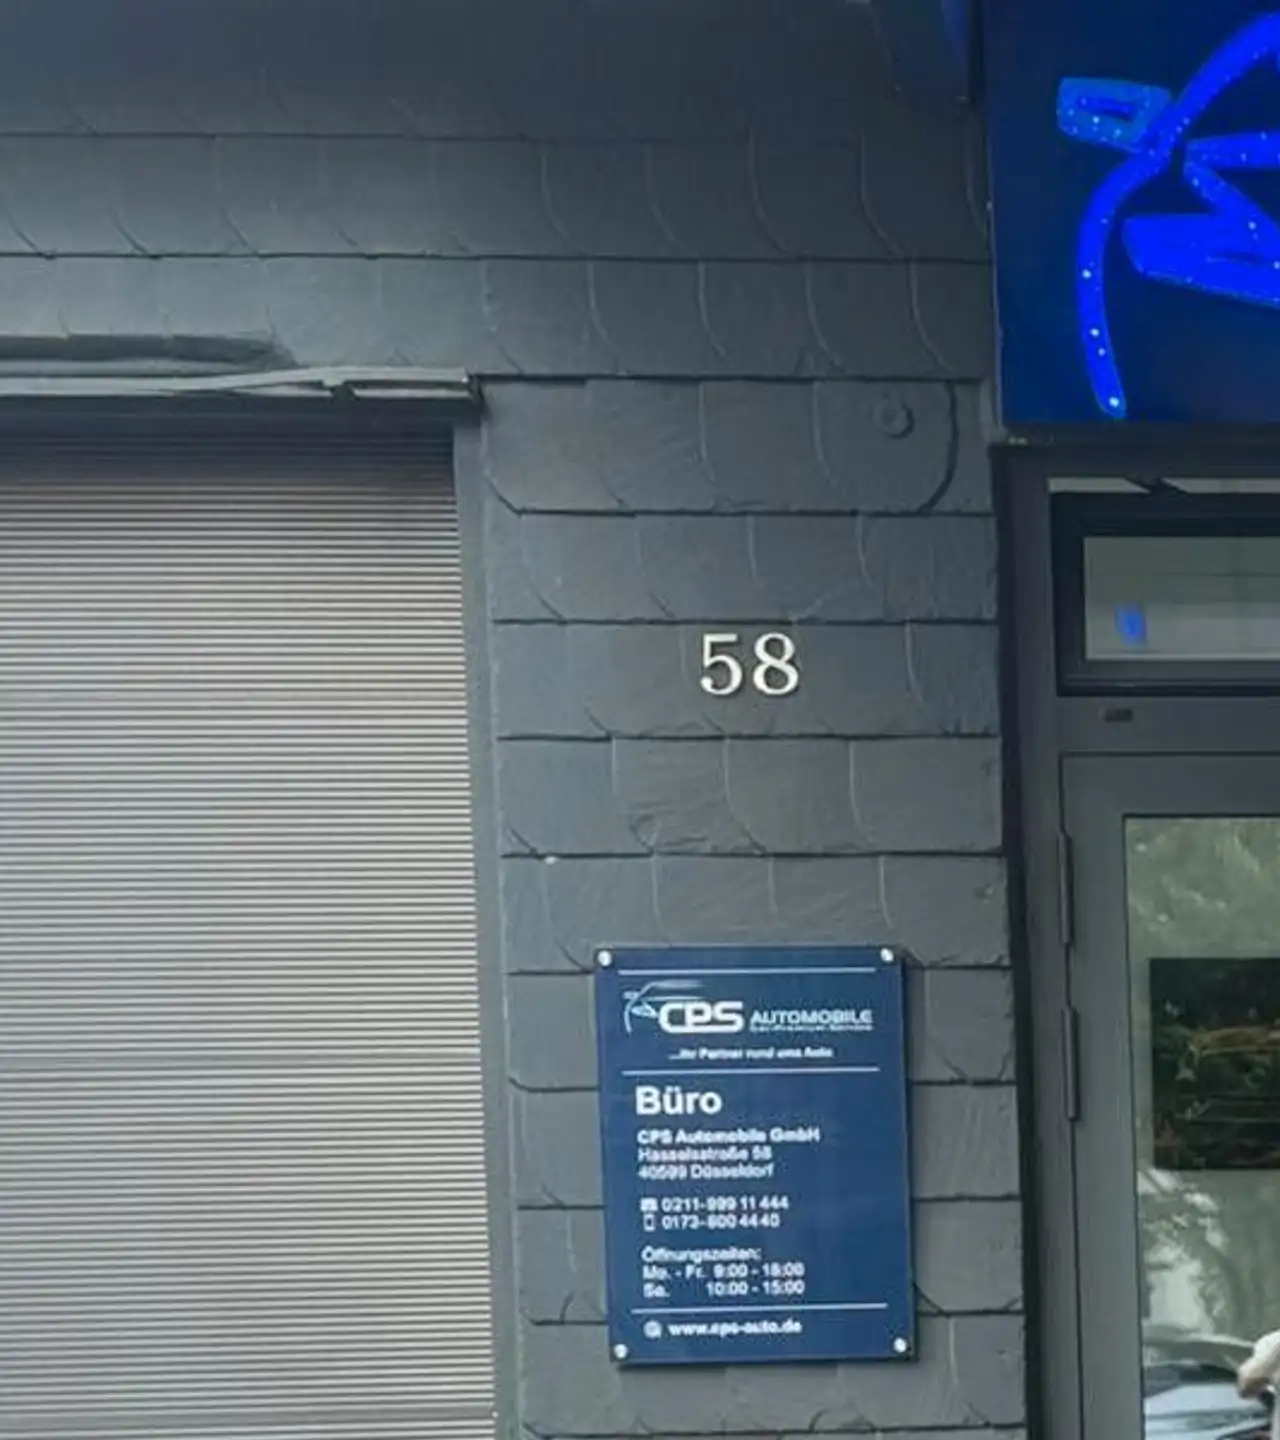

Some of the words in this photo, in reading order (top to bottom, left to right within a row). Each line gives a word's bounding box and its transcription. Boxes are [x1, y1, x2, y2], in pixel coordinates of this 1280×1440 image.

[700, 632, 799, 695] 58
[658, 1000, 744, 1034] CPS
[750, 1009, 873, 1024] AUTOMOBILE
[635, 1085, 723, 1115] Büro
[636, 1129, 673, 1144] CPS
[675, 1128, 767, 1143] Automobile
[769, 1126, 821, 1142] GmbH
[690, 1162, 775, 1179] Düsseldorf
[641, 1245, 762, 1264] Öffnungszeiten:
[706, 1281, 749, 1298] 10:00
